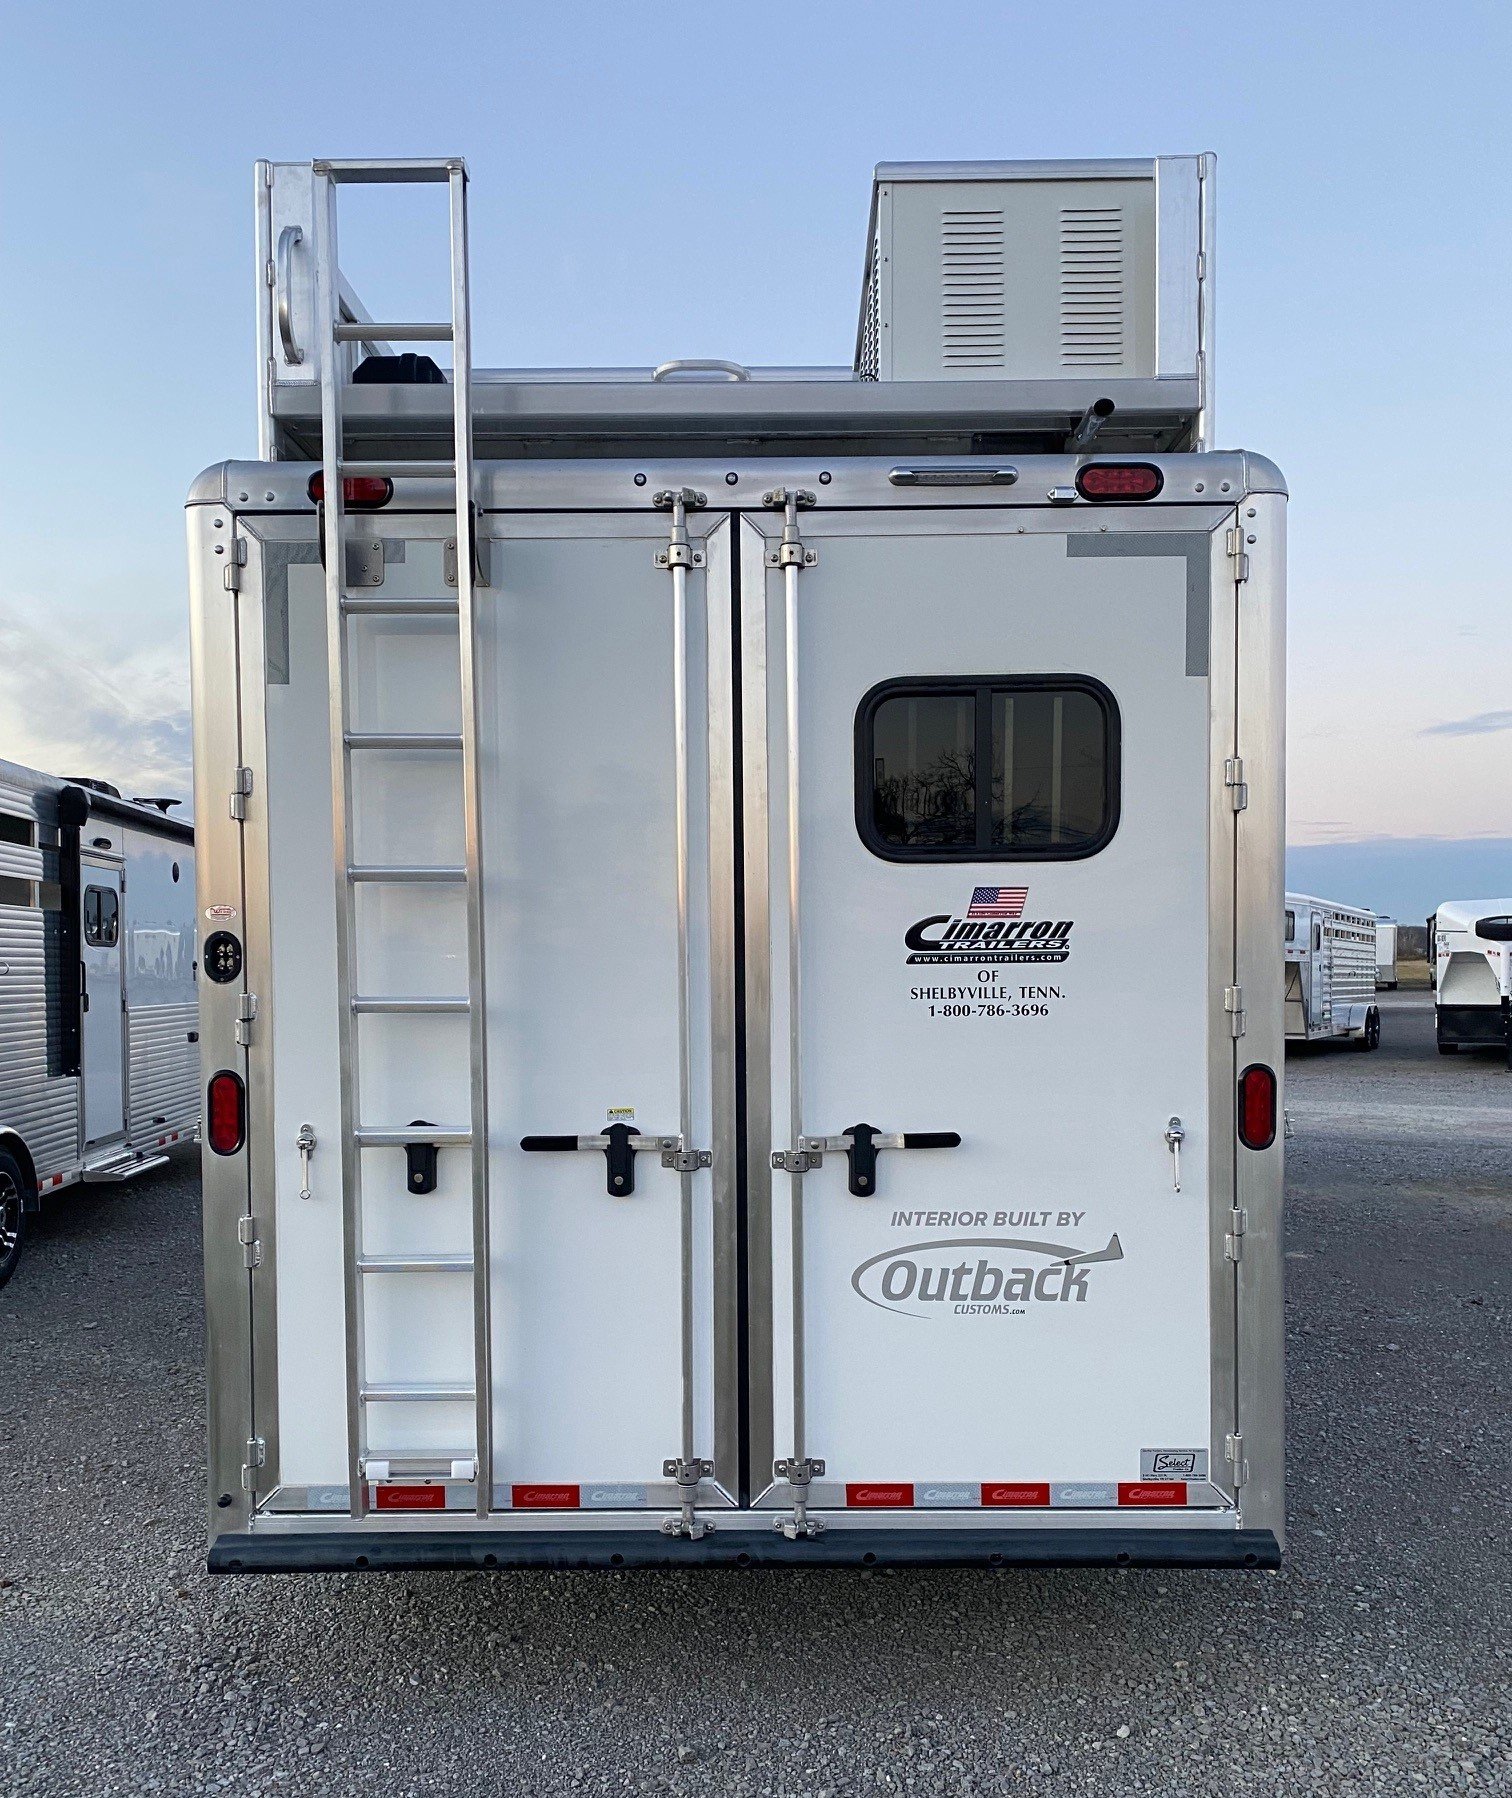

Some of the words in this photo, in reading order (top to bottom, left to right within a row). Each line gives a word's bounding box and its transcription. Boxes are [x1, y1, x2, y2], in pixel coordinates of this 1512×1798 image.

[905, 915, 1074, 951] Cimarron
[938, 940, 1064, 950] TRAILERS
[914, 954, 1061, 963] www.cimarrontrailers.com
[977, 970, 999, 983] OF
[910, 987, 1012, 1001] SHELBYVILLE,
[1019, 986, 1066, 999] TENN.
[928, 1004, 1049, 1017] 1-800-786-3696
[890, 1211, 988, 1227] INTERIOR
[992, 1211, 1052, 1227] BUILT
[1056, 1211, 1086, 1227] BY
[881, 1259, 1091, 1302] Outback
[1157, 1455, 1191, 1470] Select
